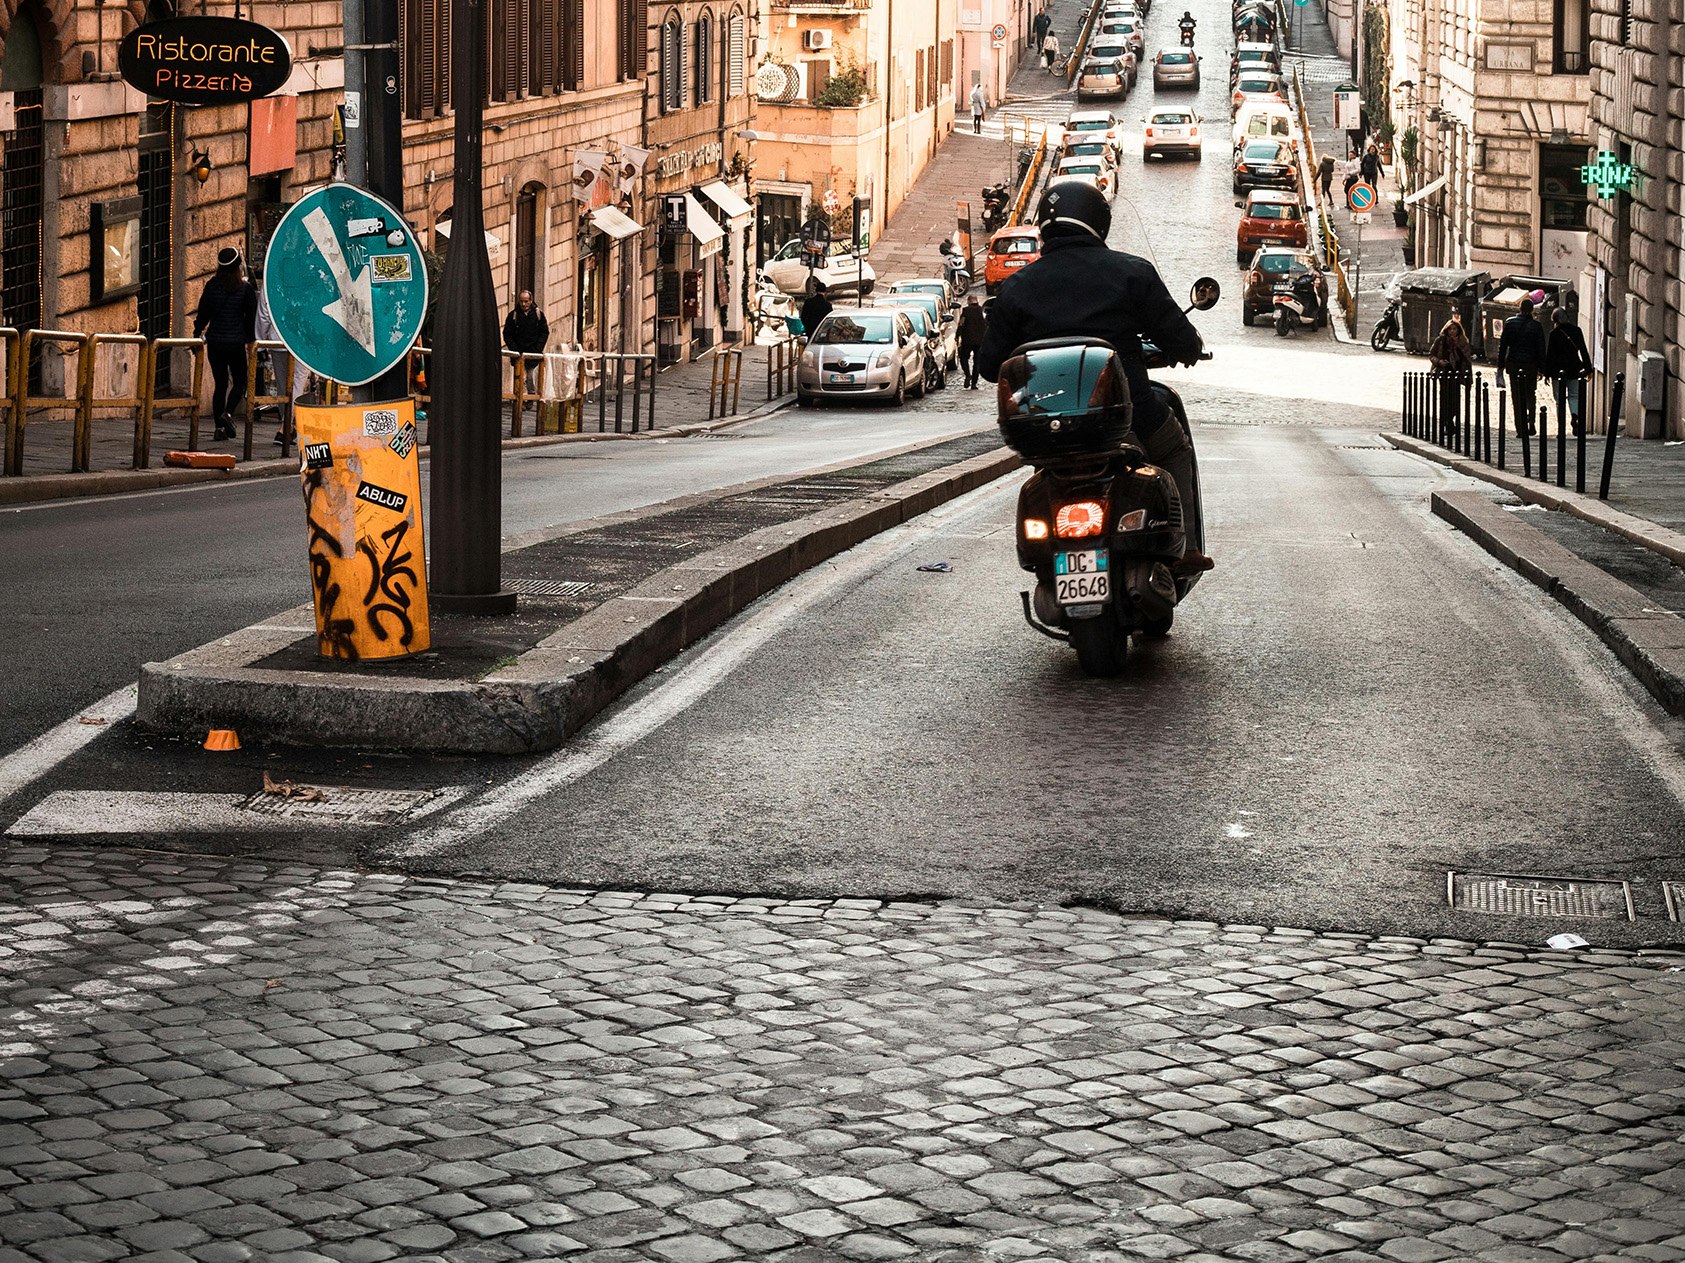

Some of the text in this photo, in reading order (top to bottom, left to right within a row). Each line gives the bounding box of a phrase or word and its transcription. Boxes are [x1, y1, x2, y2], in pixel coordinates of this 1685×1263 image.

[136, 34, 276, 65] Ristorante
[1493, 60, 1525, 69] URBANA
[156, 68, 253, 93] Pizzeria
[667, 197, 684, 222] T
[359, 485, 405, 508] ABLUP
[1067, 552, 1087, 573] DG
[1058, 576, 1108, 601] 26648
